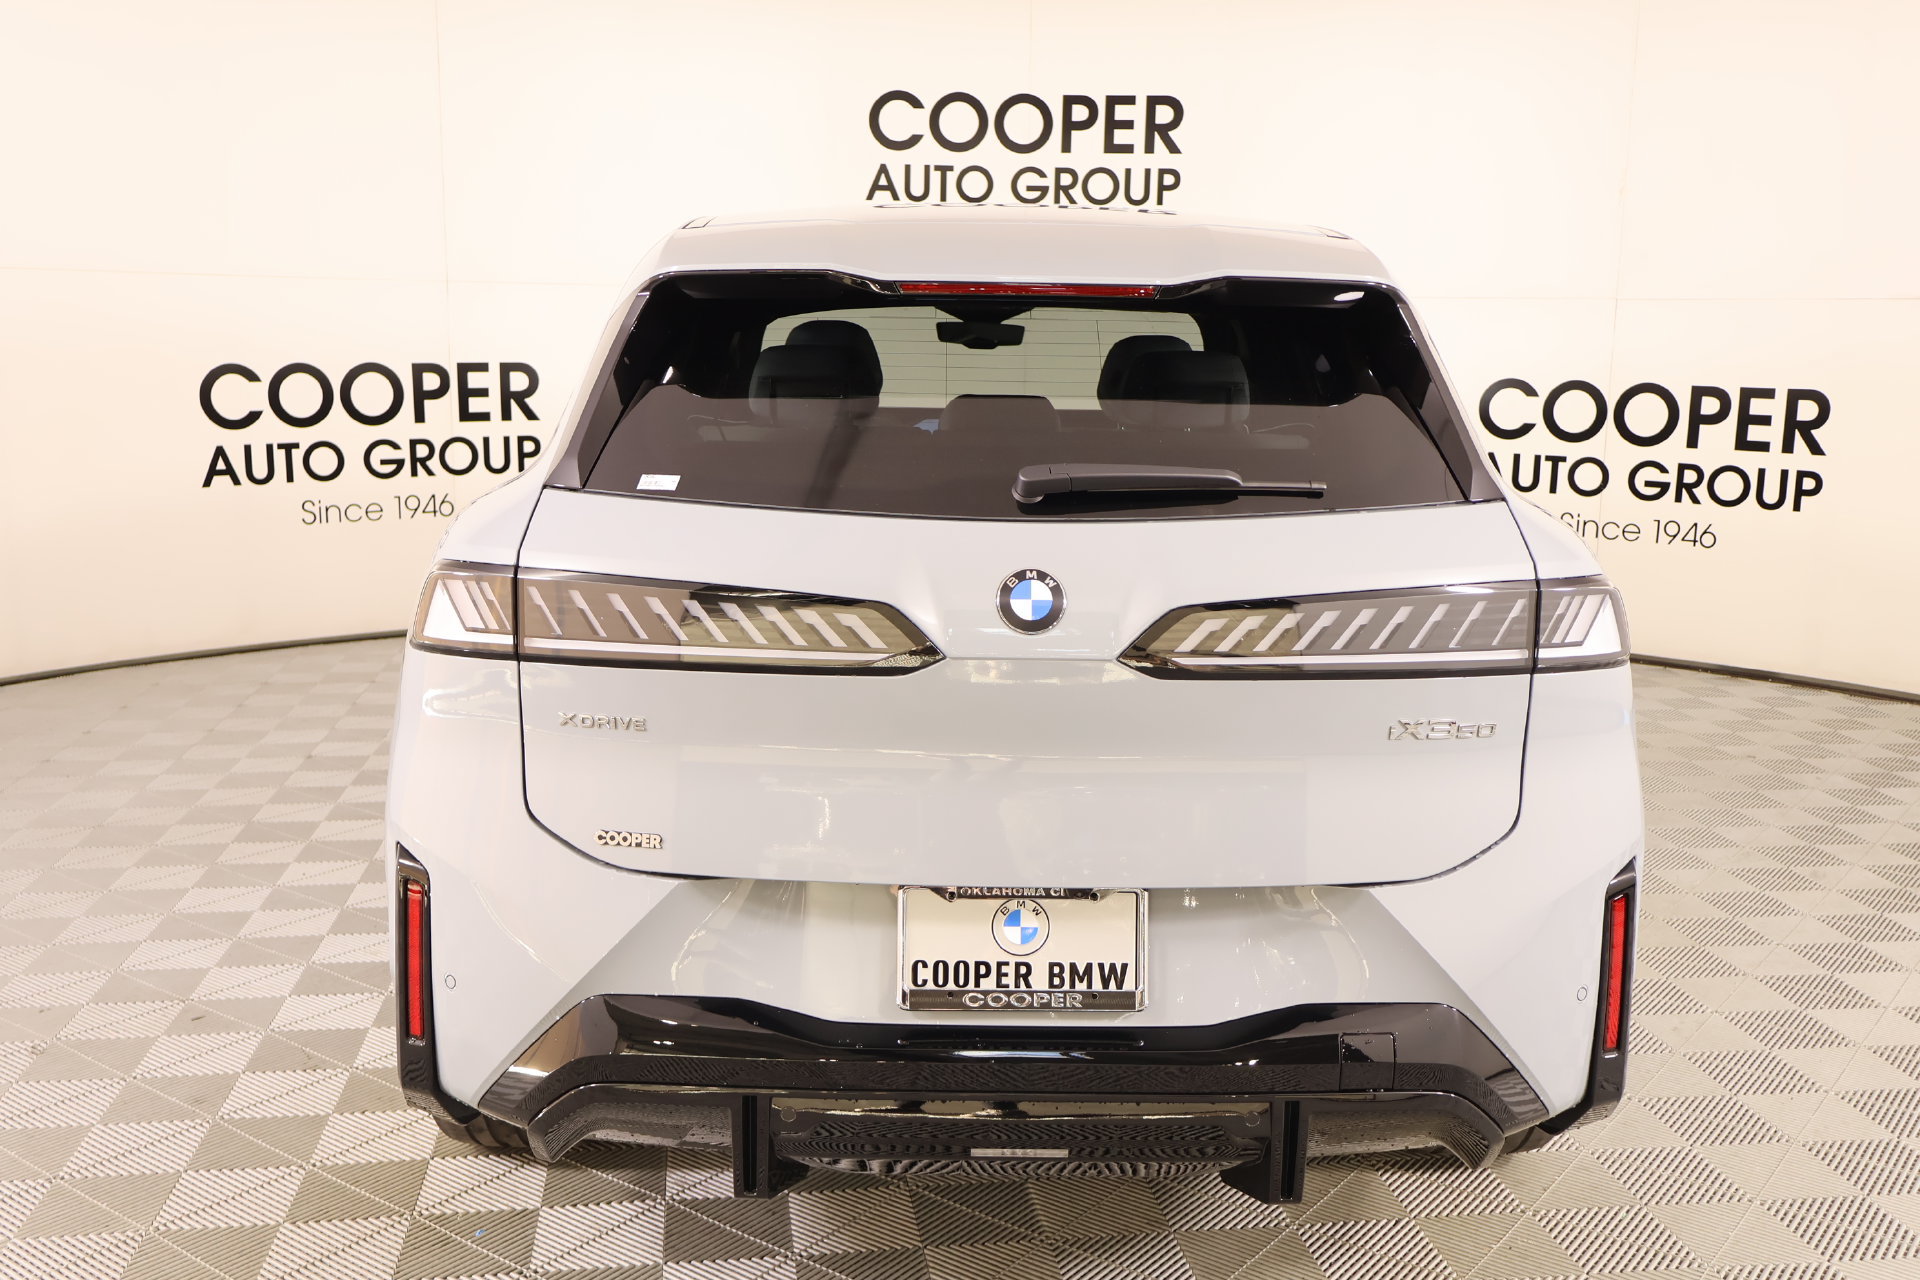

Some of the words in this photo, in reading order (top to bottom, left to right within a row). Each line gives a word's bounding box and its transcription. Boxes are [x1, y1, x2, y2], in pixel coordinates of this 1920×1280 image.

[868, 89, 1185, 155] COOPER
[865, 163, 994, 204] AUTO
[1010, 166, 1181, 206] GROUP
[199, 361, 541, 430] COOPER
[1478, 377, 1831, 456] COOPER
[201, 440, 345, 488] AUTO
[363, 435, 542, 480] GROUP
[1627, 460, 1824, 513] GROUP
[301, 499, 384, 525] Since
[394, 493, 455, 520] 1946
[1653, 518, 1717, 549] 1946
[1006, 570, 1058, 588] BMW
[594, 829, 662, 849] COOPER
[960, 887, 1046, 897] OKLAHOMA
[1000, 900, 1042, 916] BMW
[910, 959, 1034, 990] COOPER
[1047, 961, 1129, 990] BMW
[962, 992, 1083, 1008] COOPER
